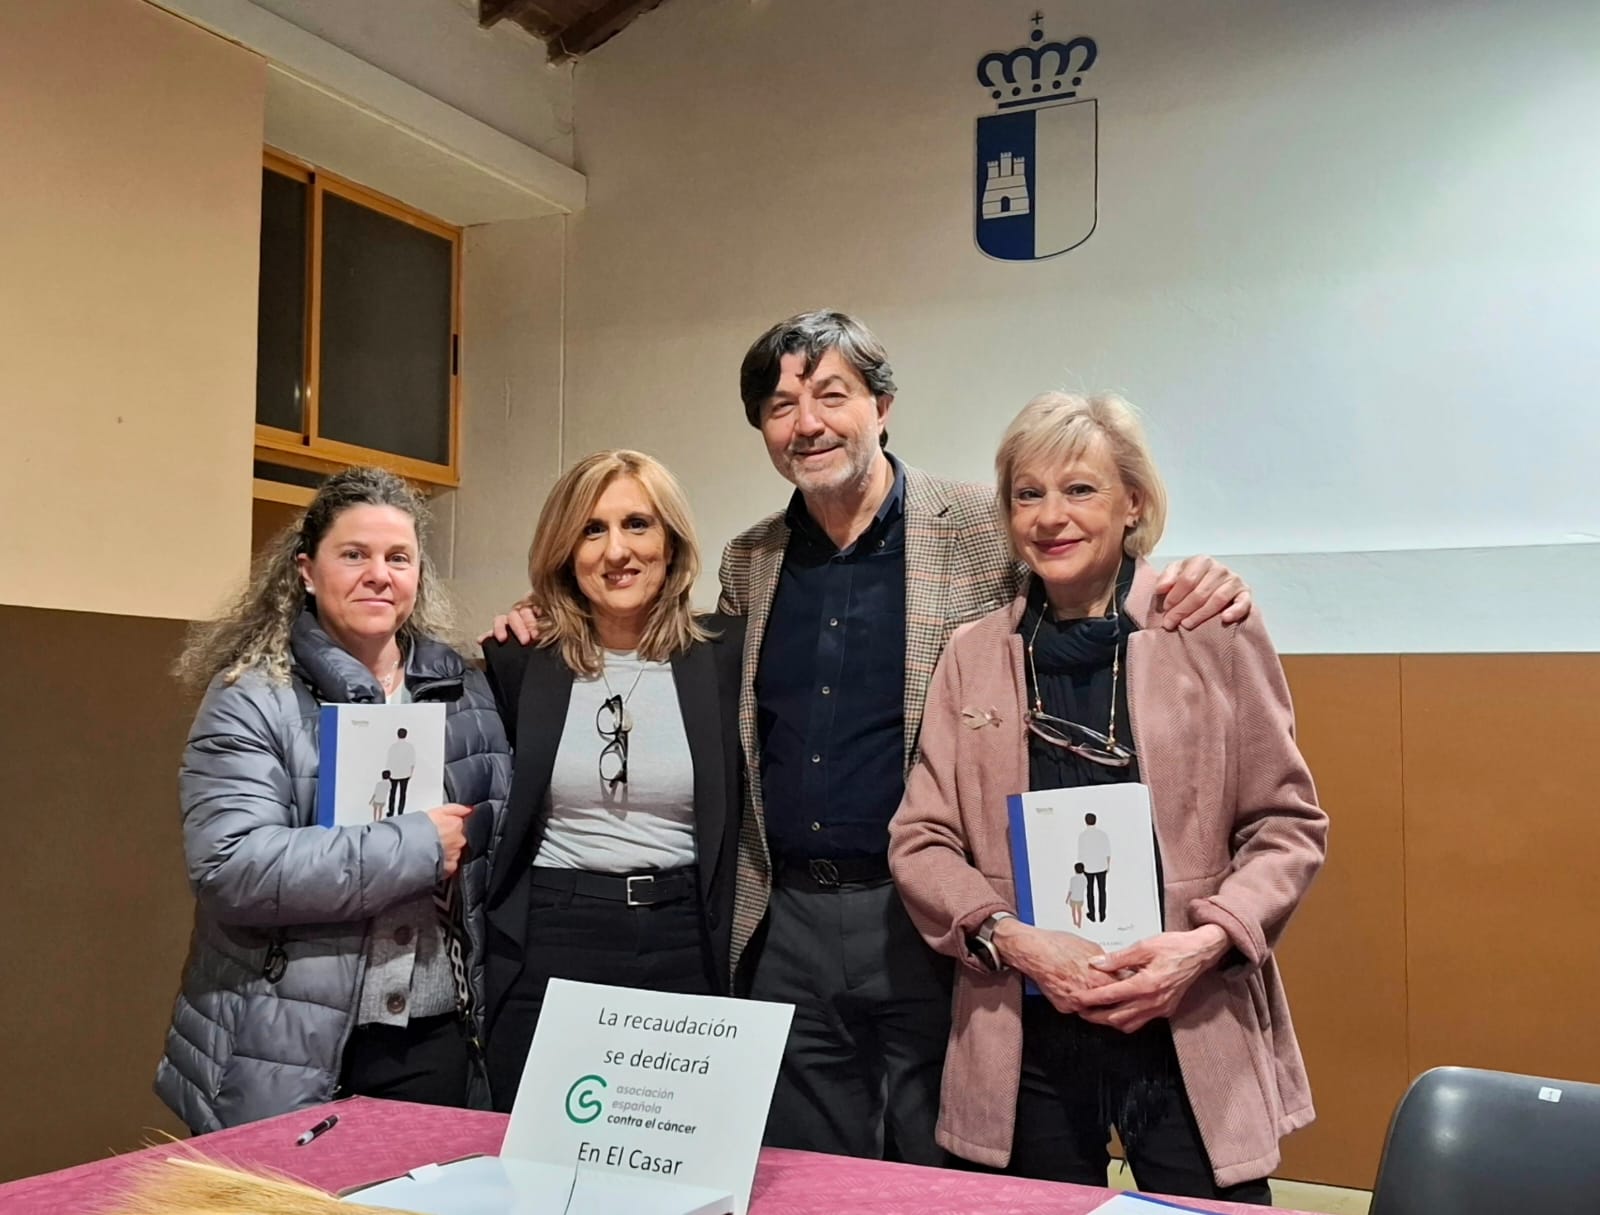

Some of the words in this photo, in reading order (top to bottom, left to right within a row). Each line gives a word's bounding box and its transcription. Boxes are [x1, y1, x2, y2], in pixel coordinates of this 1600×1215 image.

[598, 1007, 618, 1026] La
[623, 1014, 738, 1039] recaudación
[603, 1049, 625, 1065] se
[629, 1048, 710, 1075] dedicará
[615, 1084, 674, 1101] asociación
[611, 1100, 662, 1115] española
[606, 1114, 643, 1127] contra
[644, 1117, 656, 1129] el
[657, 1119, 697, 1135] cáncer
[577, 1141, 601, 1164] En
[605, 1145, 625, 1167] El
[628, 1149, 683, 1176] Casar
